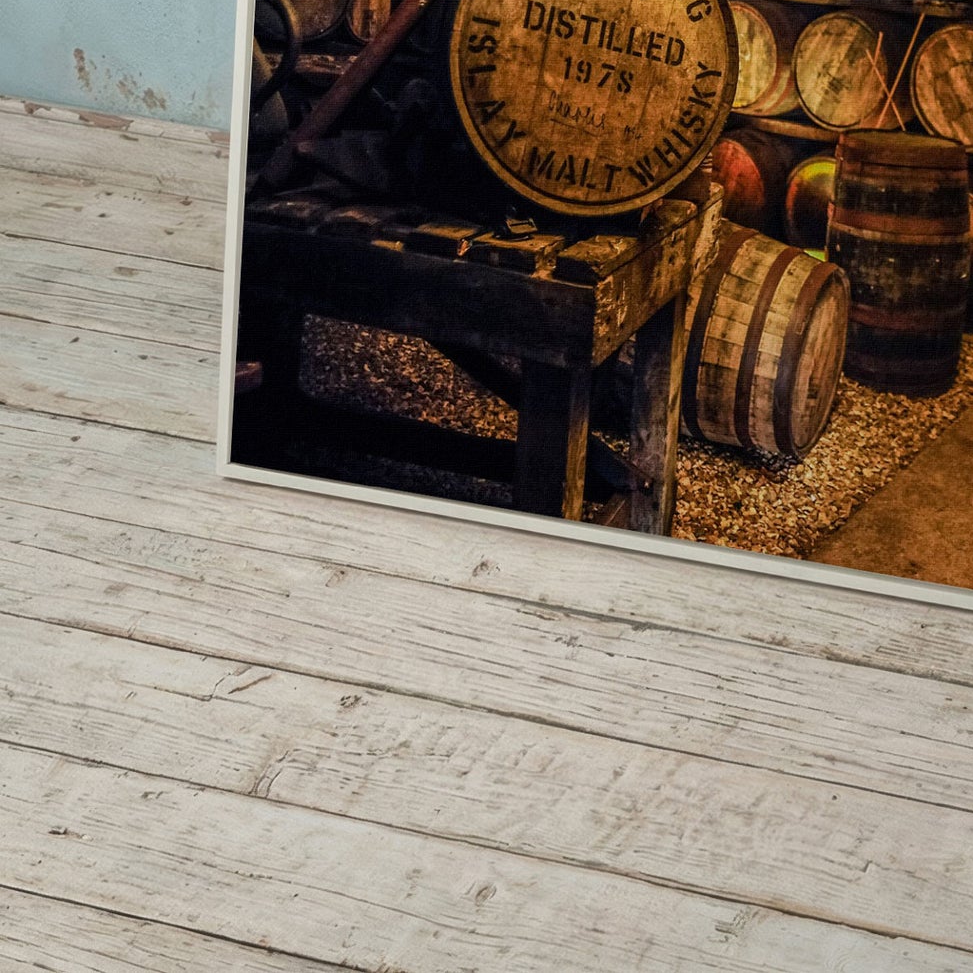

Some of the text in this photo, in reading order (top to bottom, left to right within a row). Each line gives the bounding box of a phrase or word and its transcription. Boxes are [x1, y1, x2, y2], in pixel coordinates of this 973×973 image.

[523, 0, 686, 67] DISTILLED
[467, 15, 723, 193] ISLAY MALT WHISKY
